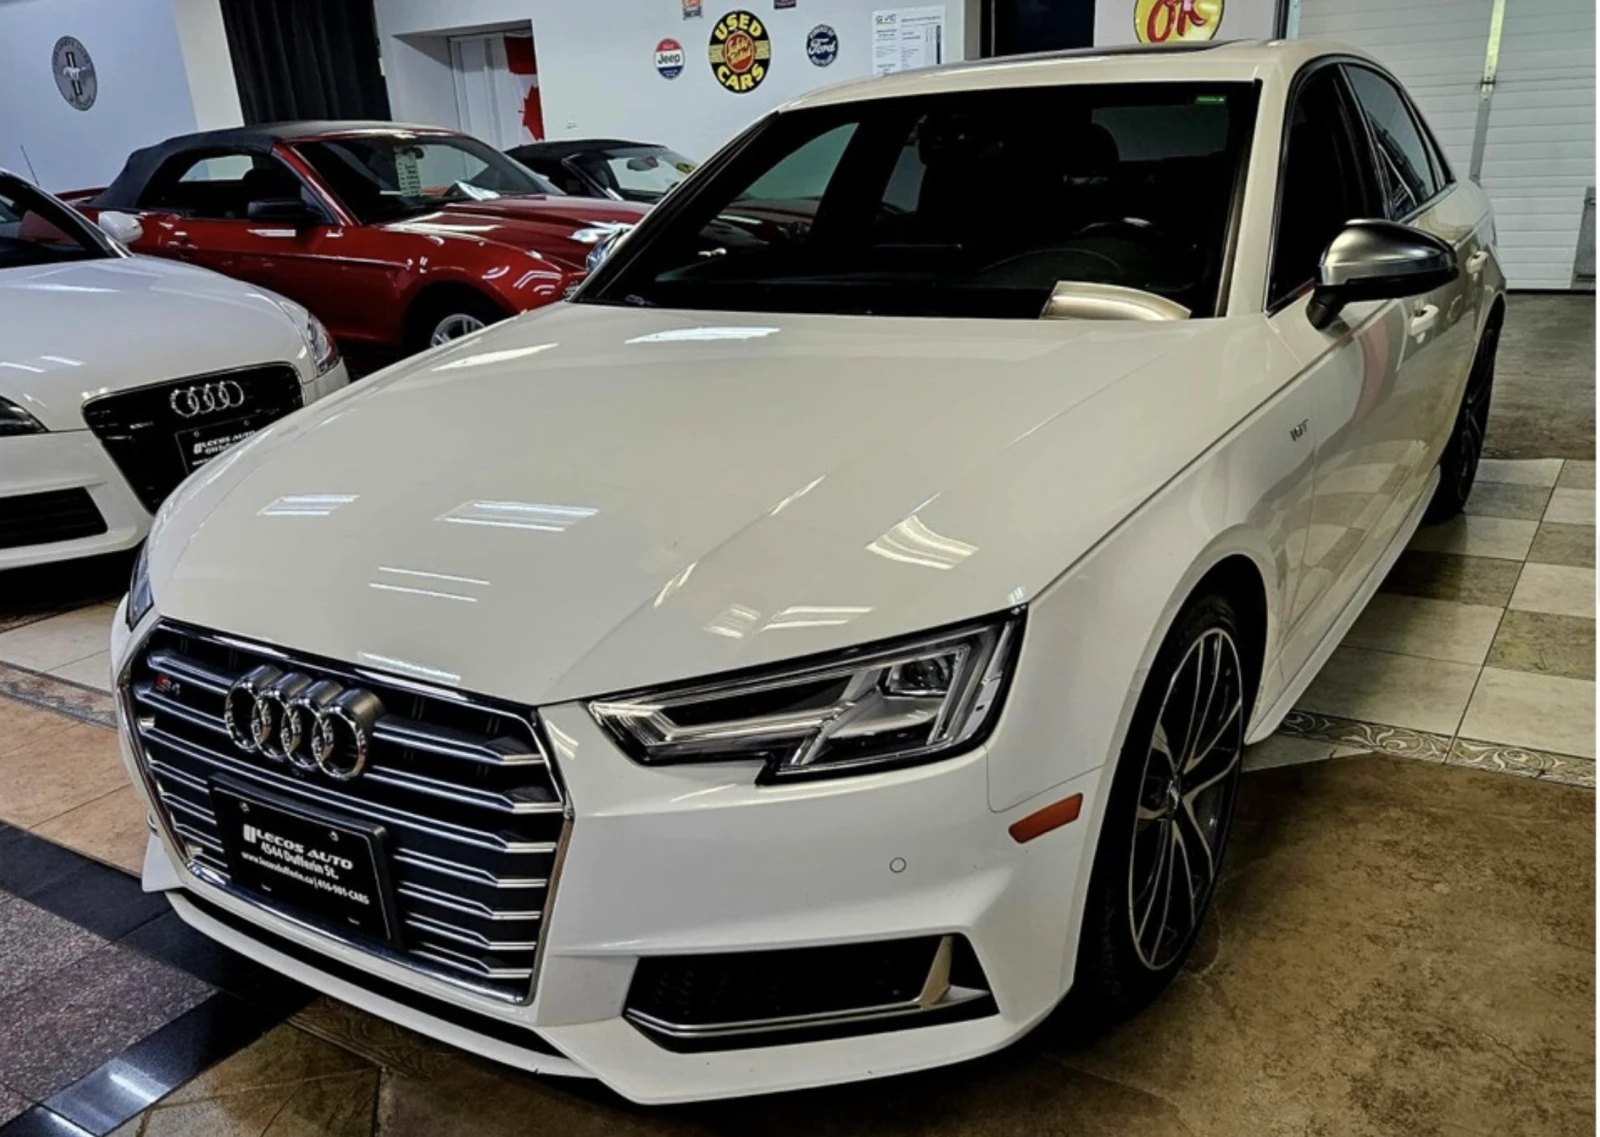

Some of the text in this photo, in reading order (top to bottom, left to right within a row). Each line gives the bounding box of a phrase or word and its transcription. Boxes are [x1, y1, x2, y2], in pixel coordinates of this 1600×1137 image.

[715, 13, 762, 40] USED
[658, 53, 681, 65] Jeep
[808, 38, 836, 55] Ford
[717, 63, 764, 90] CARS
[256, 829, 354, 870] LECOS AUTO
[261, 841, 284, 859] 4544
[283, 850, 324, 875] Dufferin
